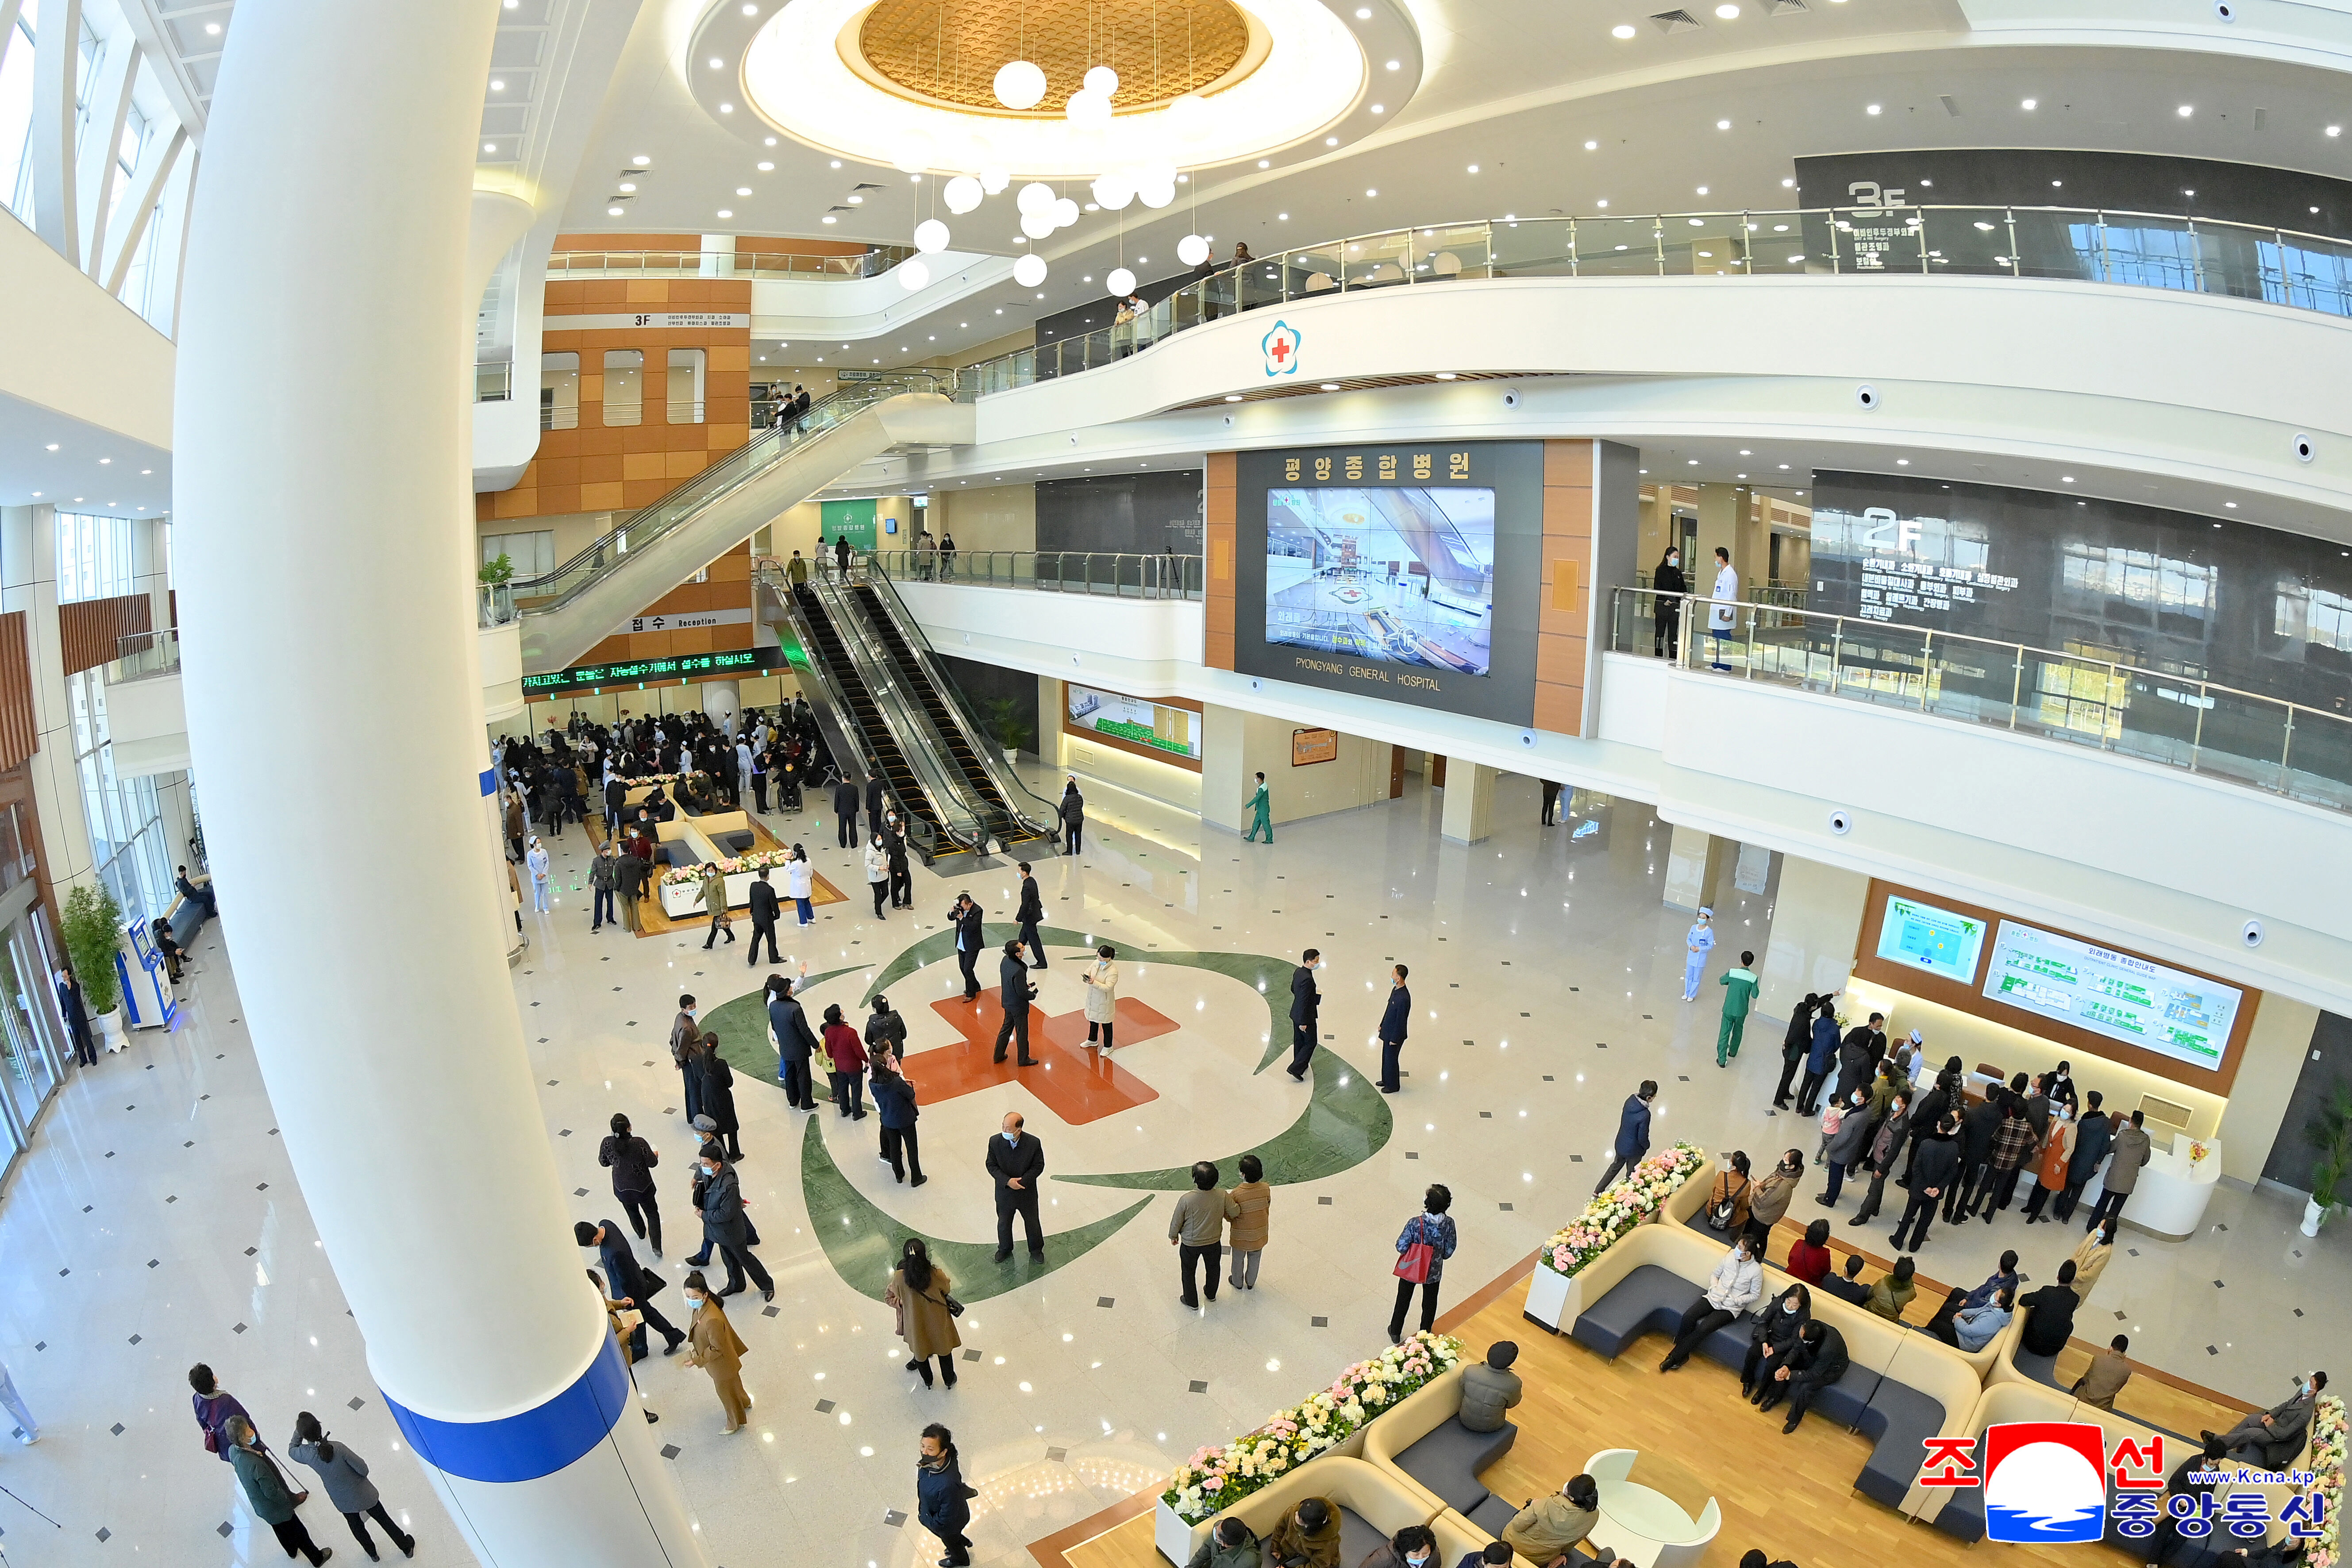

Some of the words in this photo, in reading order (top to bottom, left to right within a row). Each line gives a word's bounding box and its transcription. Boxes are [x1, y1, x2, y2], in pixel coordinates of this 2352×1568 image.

[1848, 181, 1905, 218] 3F
[635, 315, 651, 326] 3F
[1863, 507, 1922, 551] 2F
[1952, 585, 1973, 598] 피부과
[678, 618, 716, 627] Reception
[1403, 633, 1414, 647] 1F
[1296, 657, 1343, 674] PYONGYANG
[1349, 666, 1390, 682] GENERAL
[1397, 673, 1441, 691] HOSPITAL
[2088, 948, 2117, 961] 외래병동
[2120, 957, 2156, 973] 종합안내도
